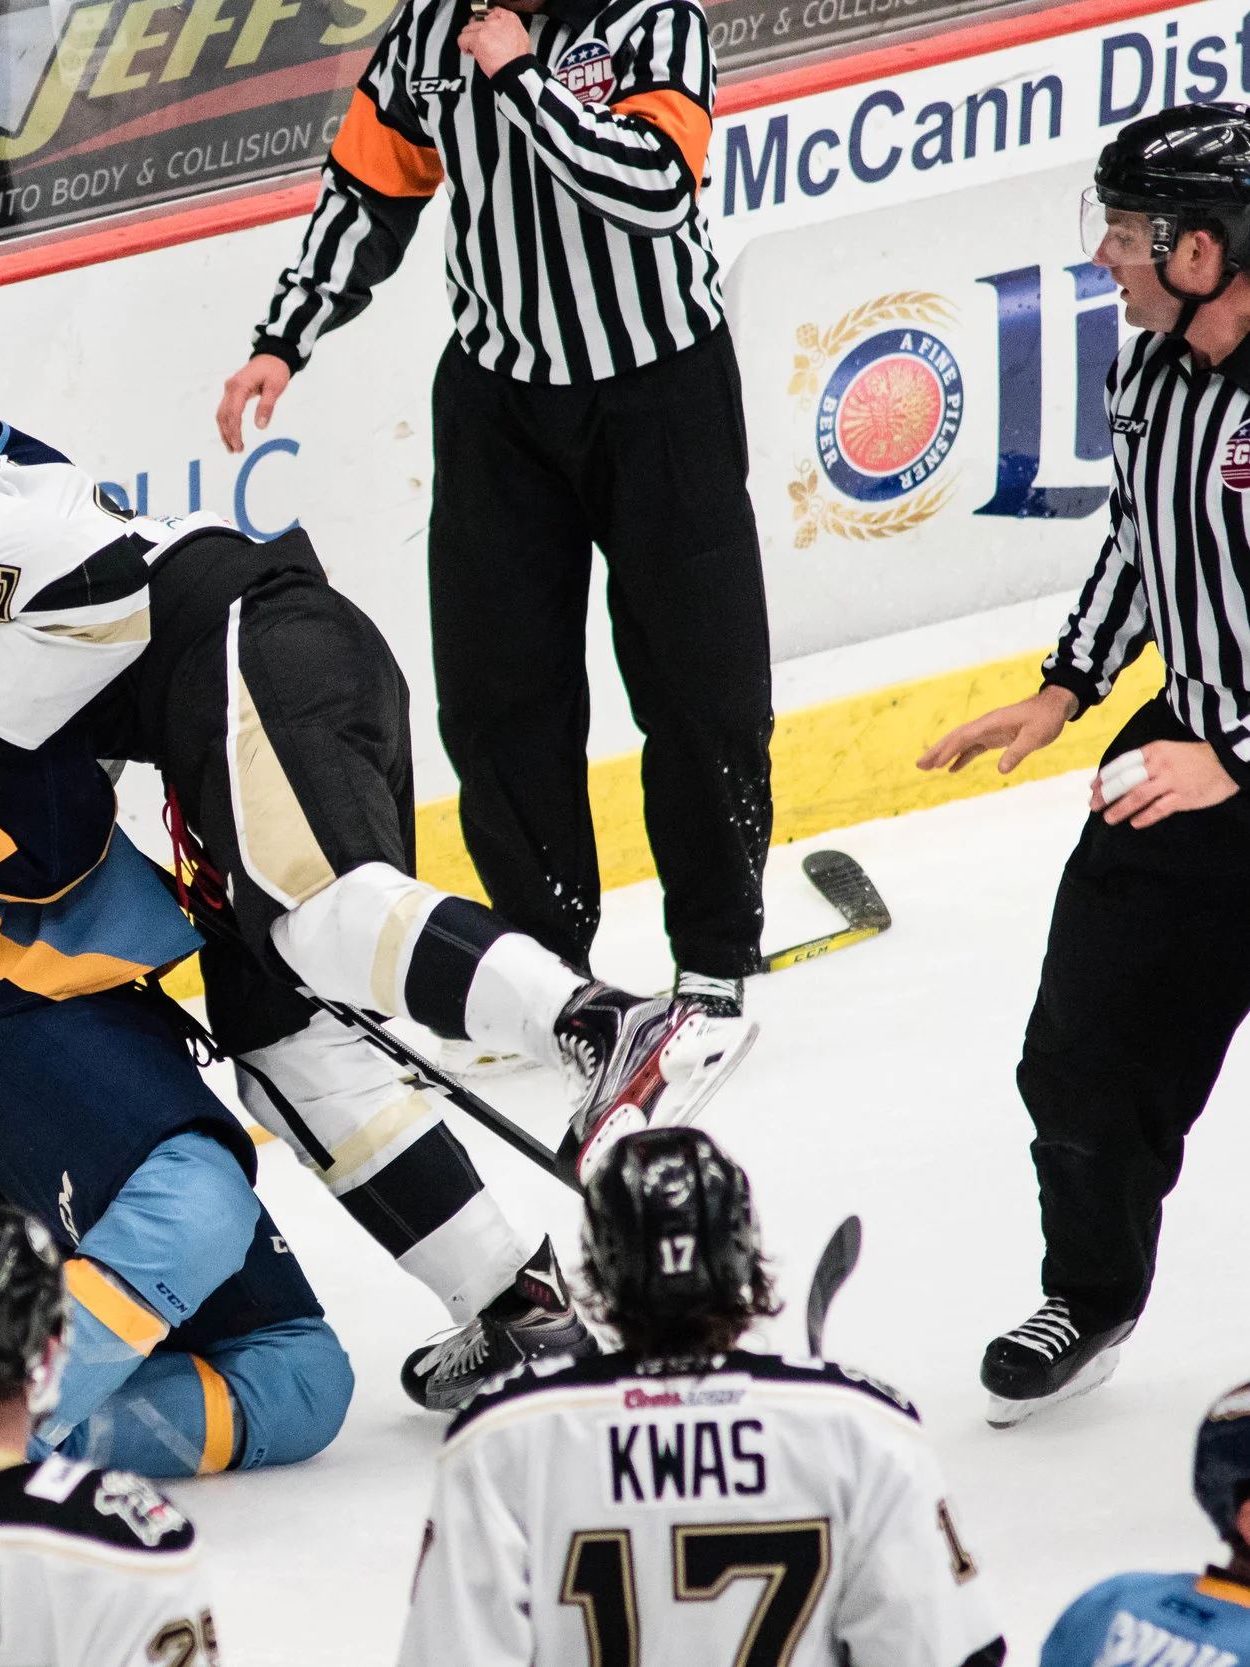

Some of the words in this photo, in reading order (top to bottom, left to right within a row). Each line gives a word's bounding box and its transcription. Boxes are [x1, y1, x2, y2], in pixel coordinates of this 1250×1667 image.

[773, 8, 791, 35] &
[50, 164, 128, 206] BODY
[136, 159, 155, 186] &
[167, 121, 314, 179] COLLISION
[723, 71, 1063, 217] McCann
[900, 333, 912, 350] A
[918, 337, 957, 386] FINE
[820, 395, 839, 469] BEER
[900, 393, 960, 489] PILSNER
[1112, 417, 1146, 434] CM
[794, 945, 828, 962] CCM
[660, 1236, 698, 1275] 17
[608, 1420, 768, 1504] KWAS
[558, 1516, 832, 1667] 17
